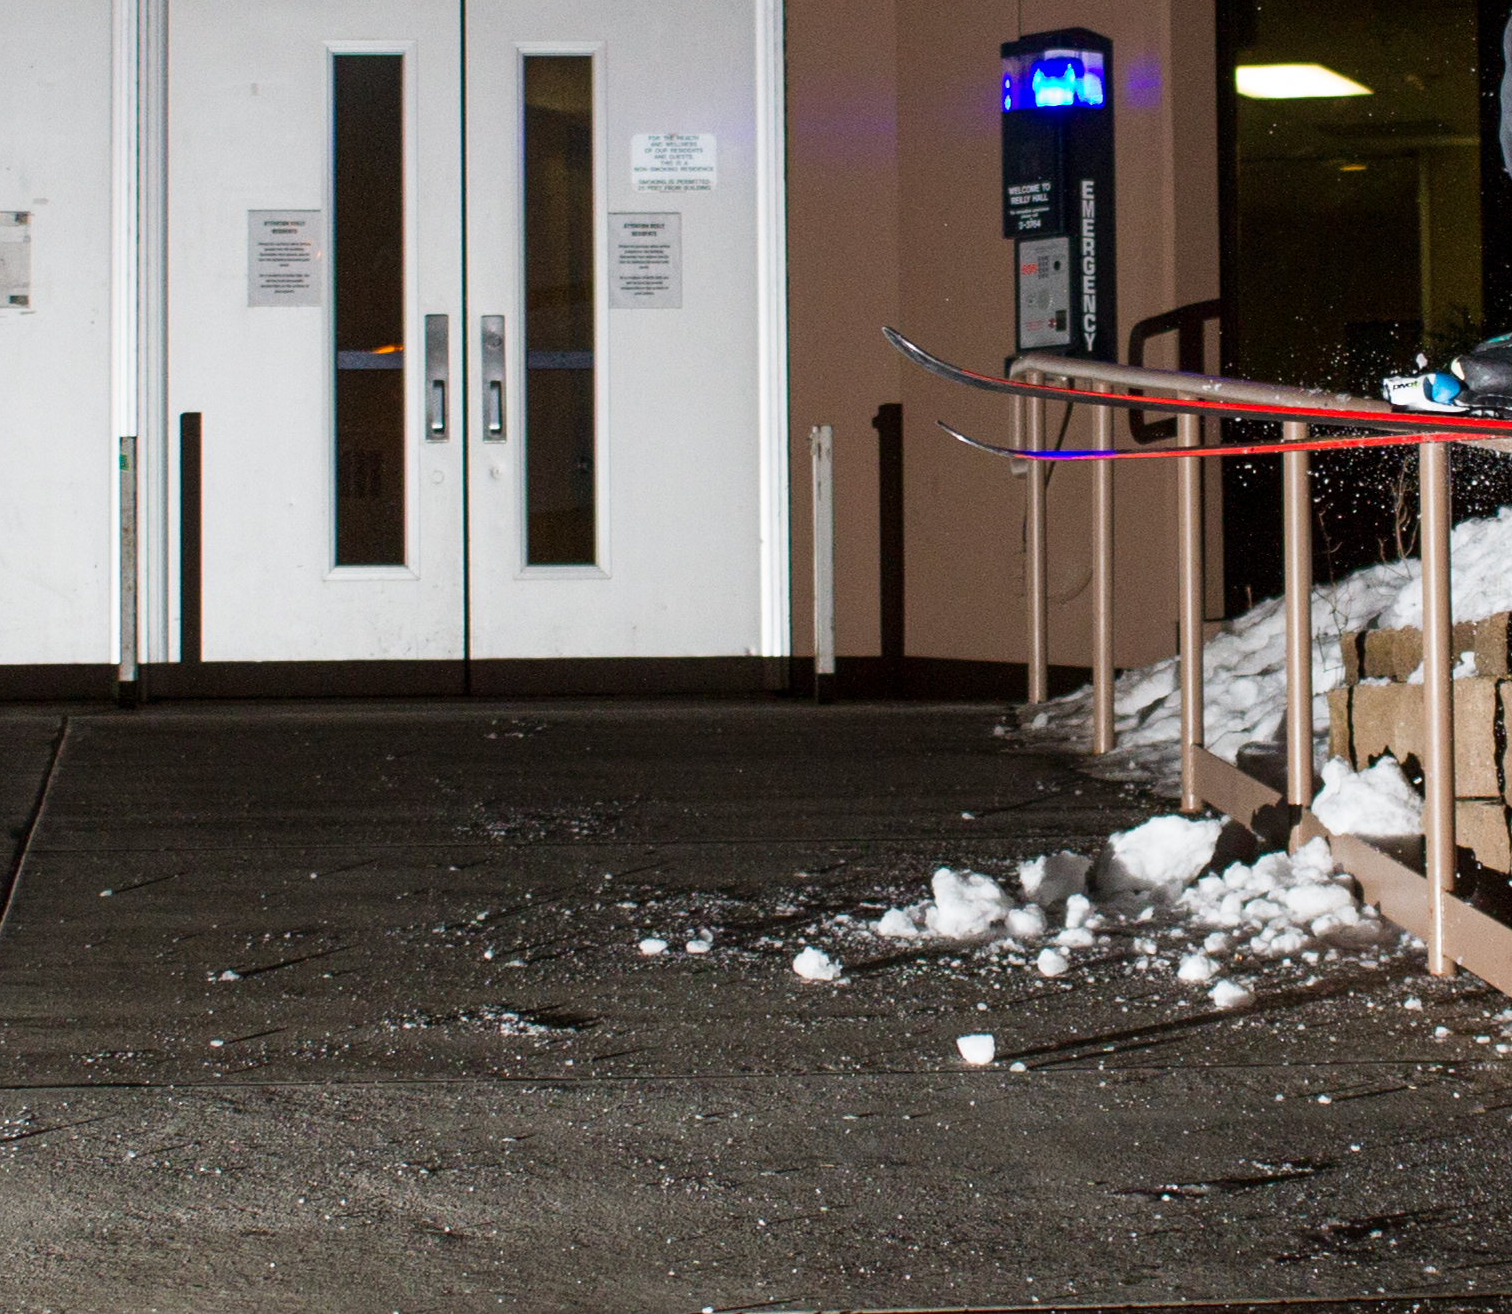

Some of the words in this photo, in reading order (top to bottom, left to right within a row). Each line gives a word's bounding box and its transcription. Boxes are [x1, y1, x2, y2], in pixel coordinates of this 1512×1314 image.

[1008, 184, 1040, 195] WELCOME
[1041, 182, 1051, 191] TO
[1010, 195, 1031, 205] REILLY
[1032, 193, 1048, 202] HALL
[1081, 180, 1096, 351] EMERGENCY
